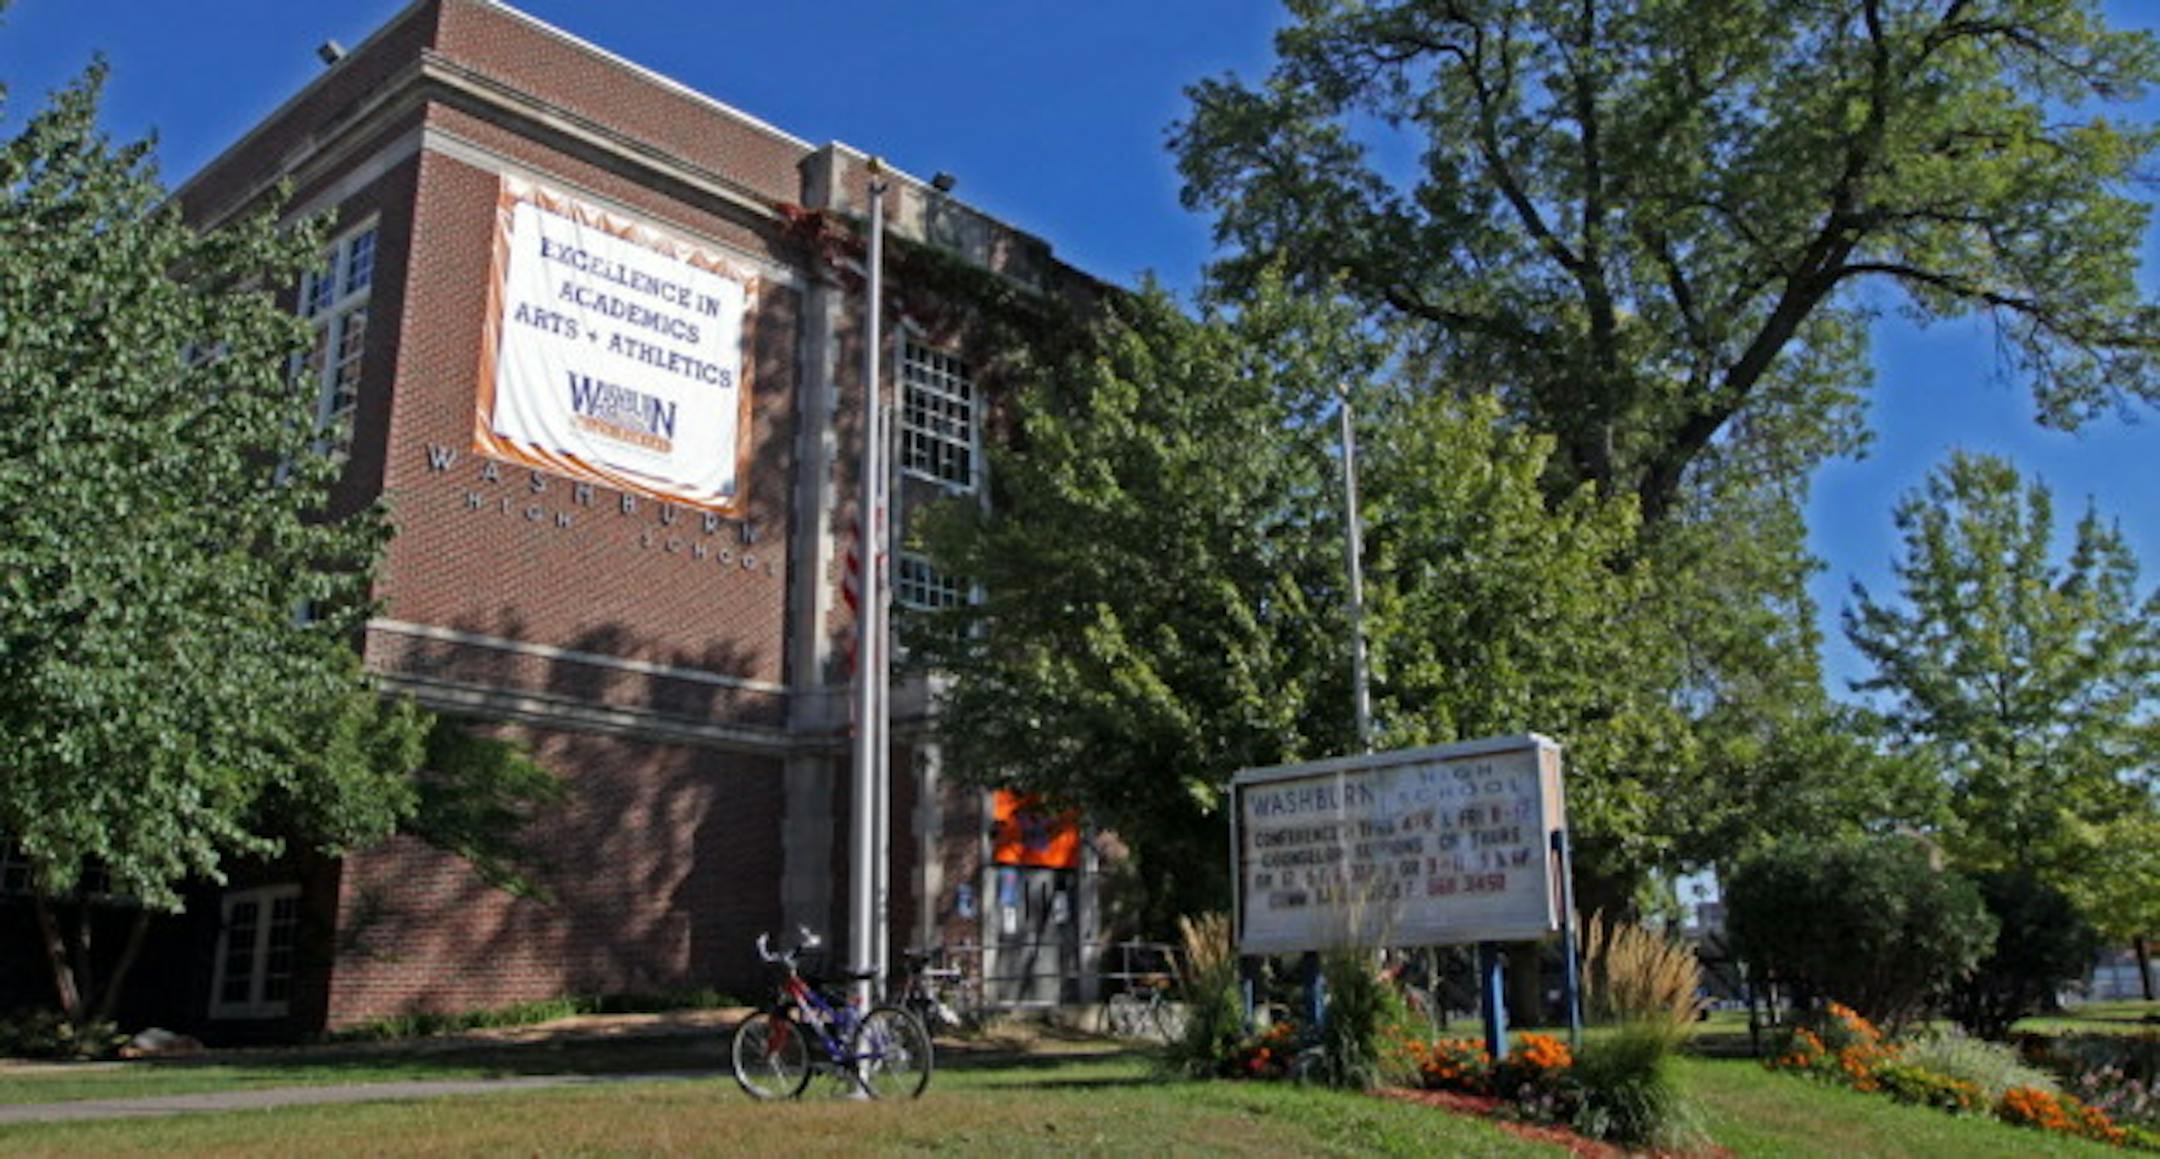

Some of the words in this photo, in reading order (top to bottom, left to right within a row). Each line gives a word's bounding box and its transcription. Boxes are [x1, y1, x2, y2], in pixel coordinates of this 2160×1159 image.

[540, 236, 692, 309] EXCELLENCE
[696, 290, 721, 318] IN
[558, 281, 701, 344] ACADEMICS
[513, 301, 579, 341] ARTS
[607, 331, 733, 389] ATHLETICS
[429, 445, 758, 545] WASHBURN
[467, 492, 571, 528] HIGH
[1252, 782, 1374, 817] WASHBURN
